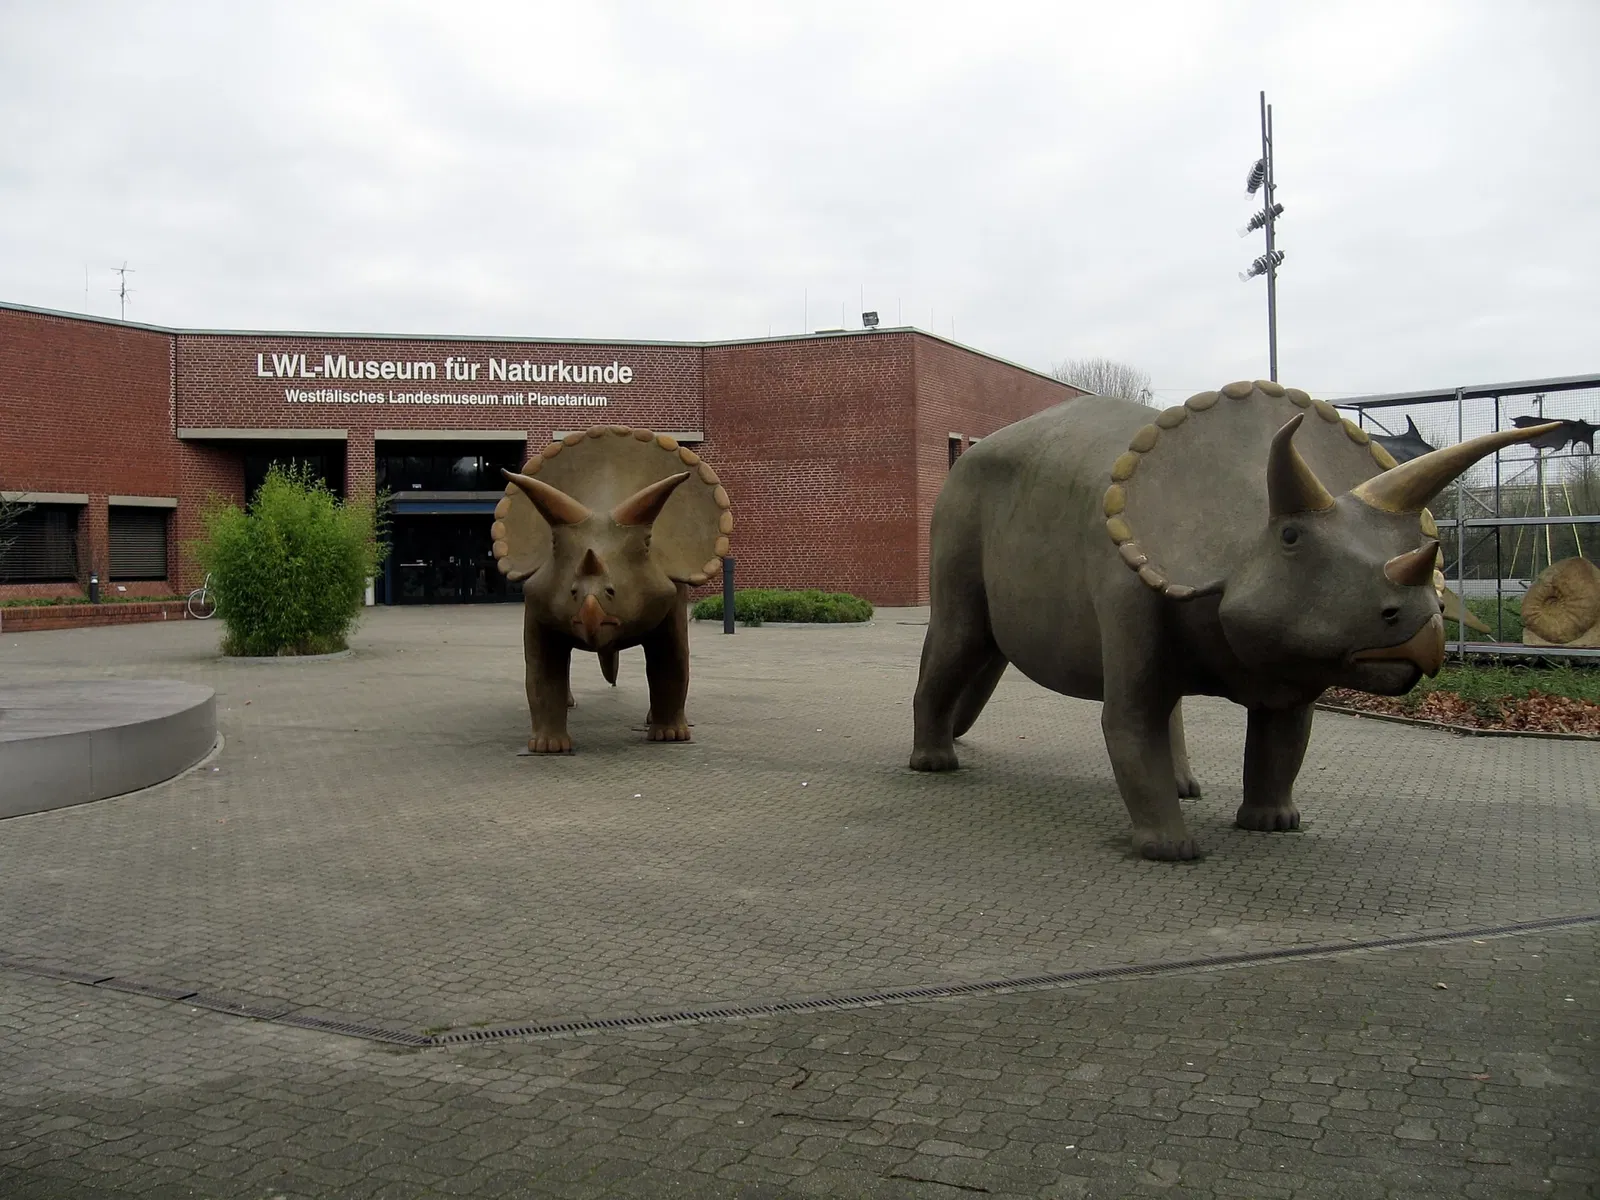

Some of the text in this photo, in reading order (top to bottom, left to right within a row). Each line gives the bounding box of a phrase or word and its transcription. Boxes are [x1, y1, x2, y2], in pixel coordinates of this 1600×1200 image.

[257, 353, 633, 384] LWL-Museum für Naturkunde
[284, 388, 608, 407] Westfälisches Landesmuseum mit Planetarium
